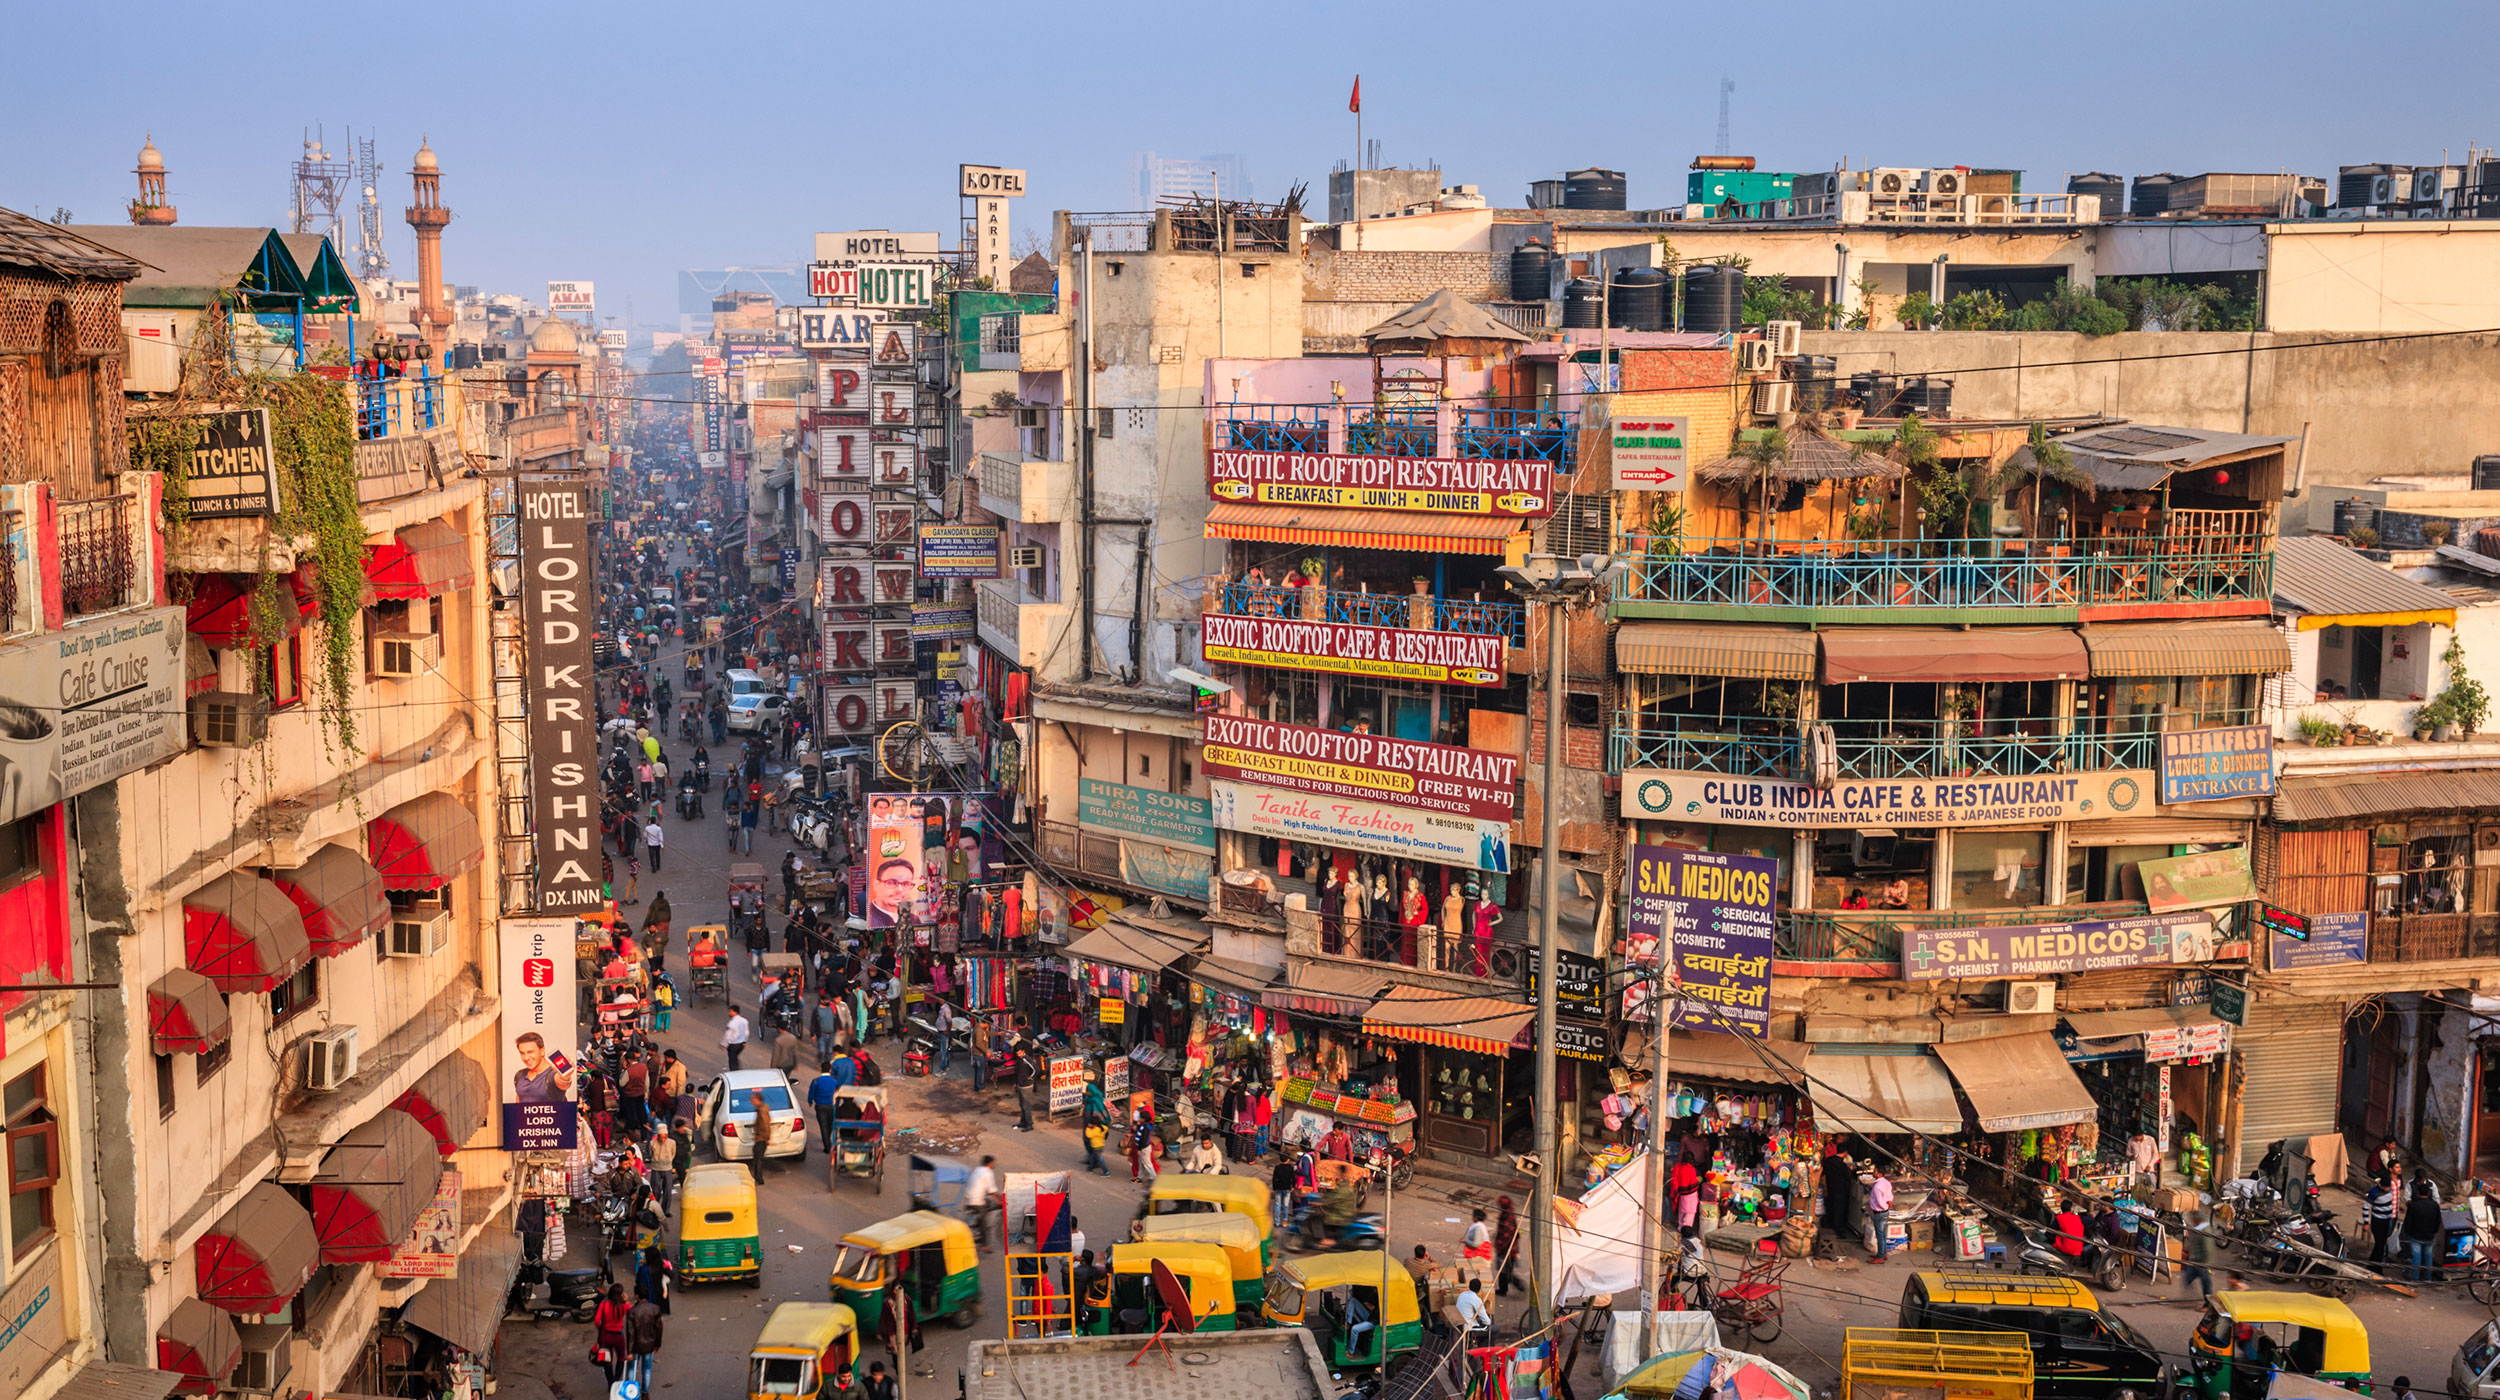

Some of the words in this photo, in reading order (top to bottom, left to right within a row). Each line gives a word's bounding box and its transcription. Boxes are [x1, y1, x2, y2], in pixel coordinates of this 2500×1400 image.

[847, 238, 904, 254] HOTEL
[549, 283, 577, 292] HOTEL
[553, 293, 590, 303] AMAN
[859, 267, 930, 305] HOTEL
[602, 334, 626, 345] HOTEL
[1620, 422, 1650, 430] ROOF
[1653, 423, 1675, 431] TOP
[1614, 436, 1646, 448] CLUB
[1649, 437, 1682, 448] INDIA
[1213, 452, 1286, 480] EXOTIC
[1290, 455, 1391, 485] ROOFTOP
[1397, 459, 1547, 491] RESTAURANT
[192, 498, 223, 513] LUNCH
[225, 498, 231, 510] &
[233, 496, 267, 510] DINNER
[525, 492, 584, 519] HOTEL
[1267, 486, 1343, 504] BREAKFAST
[1362, 490, 1407, 507] LUNCH
[1427, 493, 1480, 511] DINNER
[932, 528, 970, 536] GAYANODAYA
[971, 528, 997, 536] CLASSES
[538, 526, 579, 644] LORD
[59, 638, 79, 659] Roof
[79, 635, 95, 656] Top
[95, 631, 112, 647] with
[113, 624, 137, 645] Everest
[139, 616, 163, 636] Garden
[1205, 617, 1258, 650] EXOTIC
[1262, 622, 1332, 655] ROOFTOP
[1335, 628, 1375, 659] CAFE
[1379, 631, 1391, 660] &
[1395, 633, 1500, 668] RESTAURANT
[1211, 647, 1237, 659] Israeli,
[1239, 649, 1266, 662] Indian,
[1268, 653, 1300, 665] Chinese,
[1302, 655, 1351, 671] Continental,
[1353, 660, 1391, 674] Maxican,
[59, 660, 96, 706] Café
[101, 653, 149, 694] Cruise
[61, 718, 75, 738] Have
[75, 713, 100, 733] Delicious
[142, 692, 154, 708] Food
[154, 688, 165, 704] With
[111, 730, 144, 753] Continental
[144, 724, 164, 740] Cuisine
[1206, 716, 1274, 750] EXOTIC
[1278, 727, 1372, 764] ROOFTOP
[1376, 740, 1517, 785] RESTAURANT
[2166, 728, 2267, 757] BREAKFAST
[103, 754, 124, 776] LUNCH
[131, 743, 155, 764] DINNER
[2167, 757, 2206, 777] LUNCH
[2210, 756, 2219, 774] &
[2222, 753, 2270, 773] DINNER
[545, 664, 592, 884] KRISHNA
[1207, 747, 1285, 771] BREAKFAST
[1289, 760, 1335, 778] LUNCH
[1339, 768, 1350, 780] &
[1354, 769, 1410, 789] DINNER
[1418, 778, 1463, 798] (FREE
[1466, 786, 1514, 809] WI-FI)
[1090, 782, 1139, 801] HIRA
[1145, 792, 1204, 813] SONS
[1240, 769, 1296, 787] REMEMBER
[1297, 778, 1311, 789] US
[1312, 781, 1332, 792] FOR
[1334, 784, 1389, 800] DELICIOUS
[1390, 792, 1419, 805] FOOD
[1421, 797, 1471, 813] SERVICES
[1703, 781, 1764, 806] CLUB
[1772, 785, 1836, 809] INDIA
[1843, 785, 1903, 809] CAFE
[1910, 785, 1927, 808] &
[1935, 779, 2079, 808] RESTAURANT
[2182, 777, 2257, 796] ENTRANCE
[1089, 806, 1119, 819] READY
[1122, 812, 1148, 825] MADE
[1150, 818, 1204, 835] GARMENTS
[1252, 813, 1270, 824] Deals
[1255, 793, 1321, 820] Tanika
[1331, 804, 1415, 834] Fashion
[1426, 817, 1434, 826] M.
[1435, 817, 1475, 832] 9810183192
[1720, 807, 1766, 821] INDIAN
[1778, 811, 1873, 823] CONTINENTAL
[1885, 810, 1943, 823] CHINESE
[1947, 810, 1957, 821] &
[1961, 807, 2026, 821] JAPANESE
[2029, 805, 2063, 818] FOOD
[1283, 818, 1300, 830] High
[1302, 821, 1329, 832] Fashion
[1329, 826, 1356, 838] Sequins
[1356, 829, 1392, 842] Garments
[1393, 834, 1411, 846] Belly
[1413, 838, 1435, 849] Dance
[1437, 842, 1464, 853] Dresses
[1638, 859, 1676, 896] S.N.
[1681, 863, 1770, 907] MEDICOS
[1722, 907, 1773, 924] SERGICAL
[2161, 915, 2199, 925] 8010187917
[2323, 914, 2360, 924] TUITION
[1674, 933, 1726, 950] COSMETIC
[1721, 921, 1772, 939] MEDICINE
[1935, 930, 1979, 940] 9205564621
[531, 933, 545, 957] trip
[1937, 938, 2000, 963] S.N.
[2010, 928, 2147, 959] MEDICOS
[531, 961, 551, 985] my
[1948, 963, 2000, 977] CHEMIST
[2012, 958, 2074, 974] PHARMACY
[2085, 953, 2138, 968] COSMETIC
[534, 989, 544, 1025] make
[1584, 1005, 1601, 1014] OPEN
[1051, 1060, 1067, 1075] HIRA
[1068, 1056, 1083, 1072] SONS
[523, 1105, 556, 1114] HOTEL
[1051, 1096, 1083, 1108] GARMENTS
[518, 1127, 562, 1137] KRISHNA
[526, 1116, 554, 1125] LORD
[522, 1140, 539, 1148] DX.
[541, 1139, 558, 1147] INN
